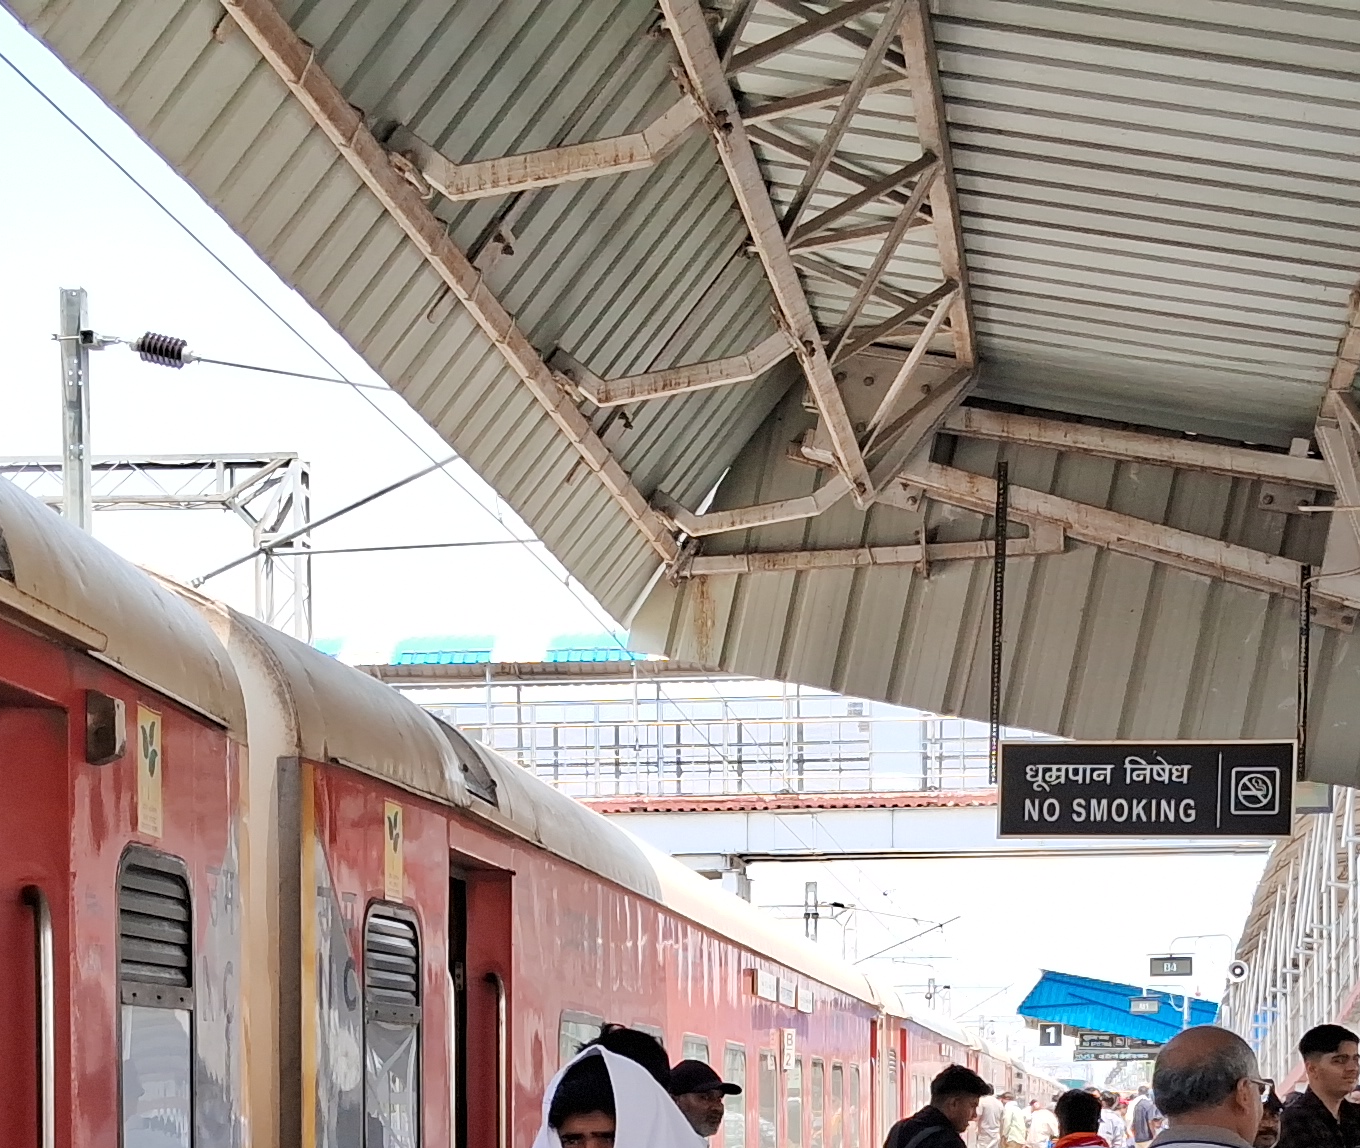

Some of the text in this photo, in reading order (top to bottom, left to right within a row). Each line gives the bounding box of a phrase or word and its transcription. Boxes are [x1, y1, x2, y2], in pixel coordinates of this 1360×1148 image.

[1025, 755, 1192, 792] धूम्रपान निषेध
[1024, 798, 1197, 823] NO SMOKING
[1045, 1026, 1056, 1044] 1
